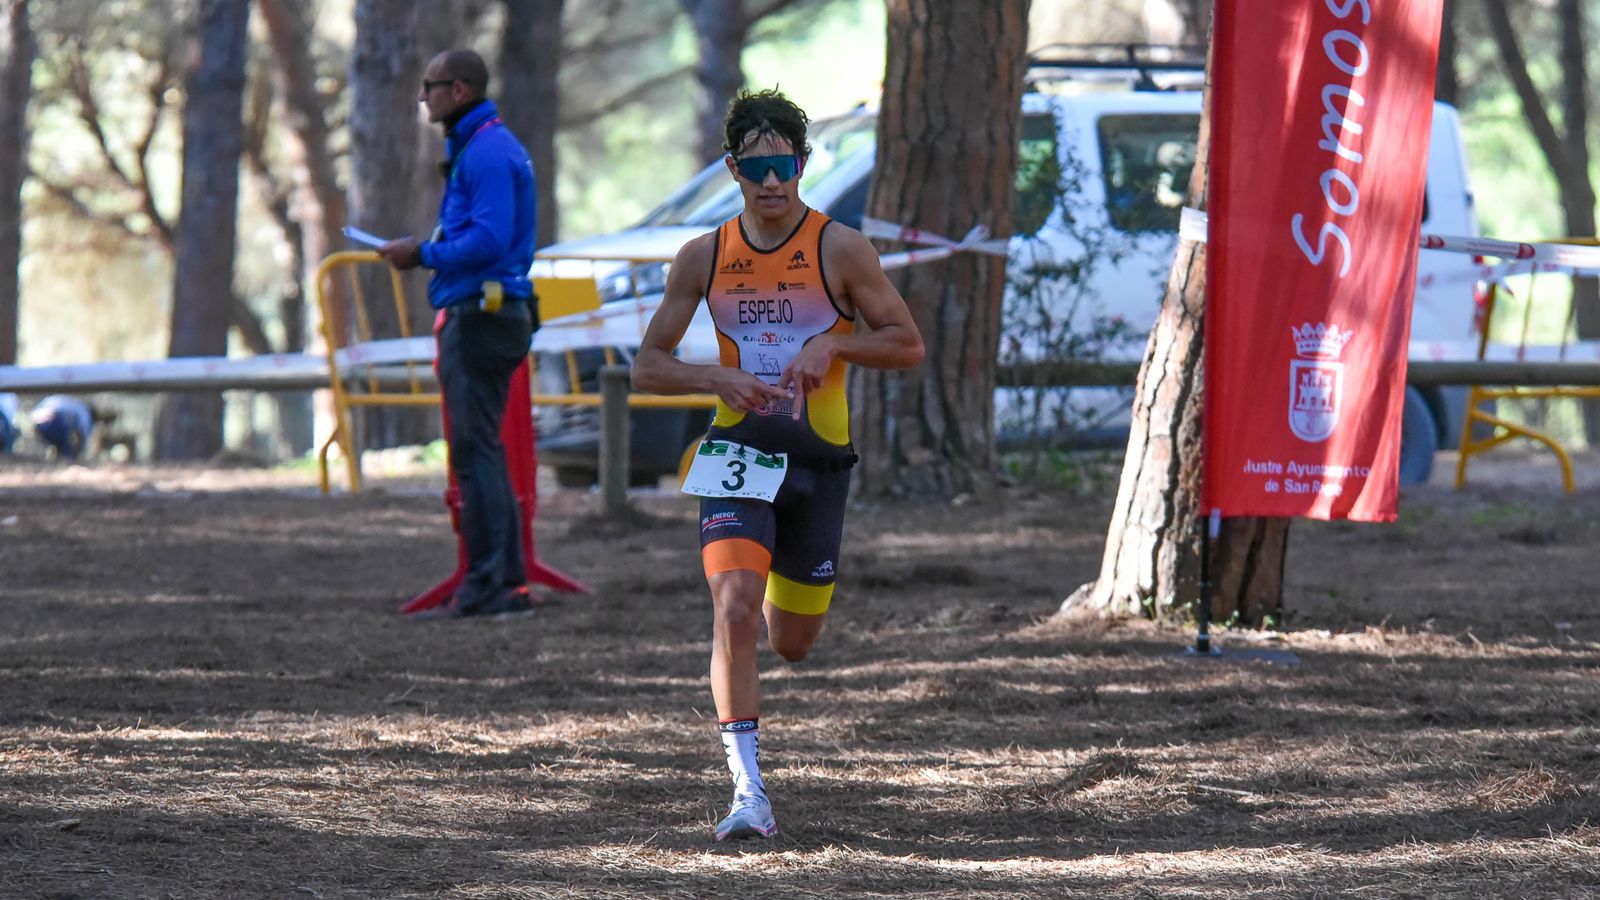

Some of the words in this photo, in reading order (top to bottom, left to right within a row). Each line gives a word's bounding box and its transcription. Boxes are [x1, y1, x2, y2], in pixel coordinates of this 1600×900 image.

[738, 298, 793, 324] ESPEJO
[721, 460, 747, 492] 3
[1264, 479, 1279, 493] de
[1284, 479, 1309, 494] San
